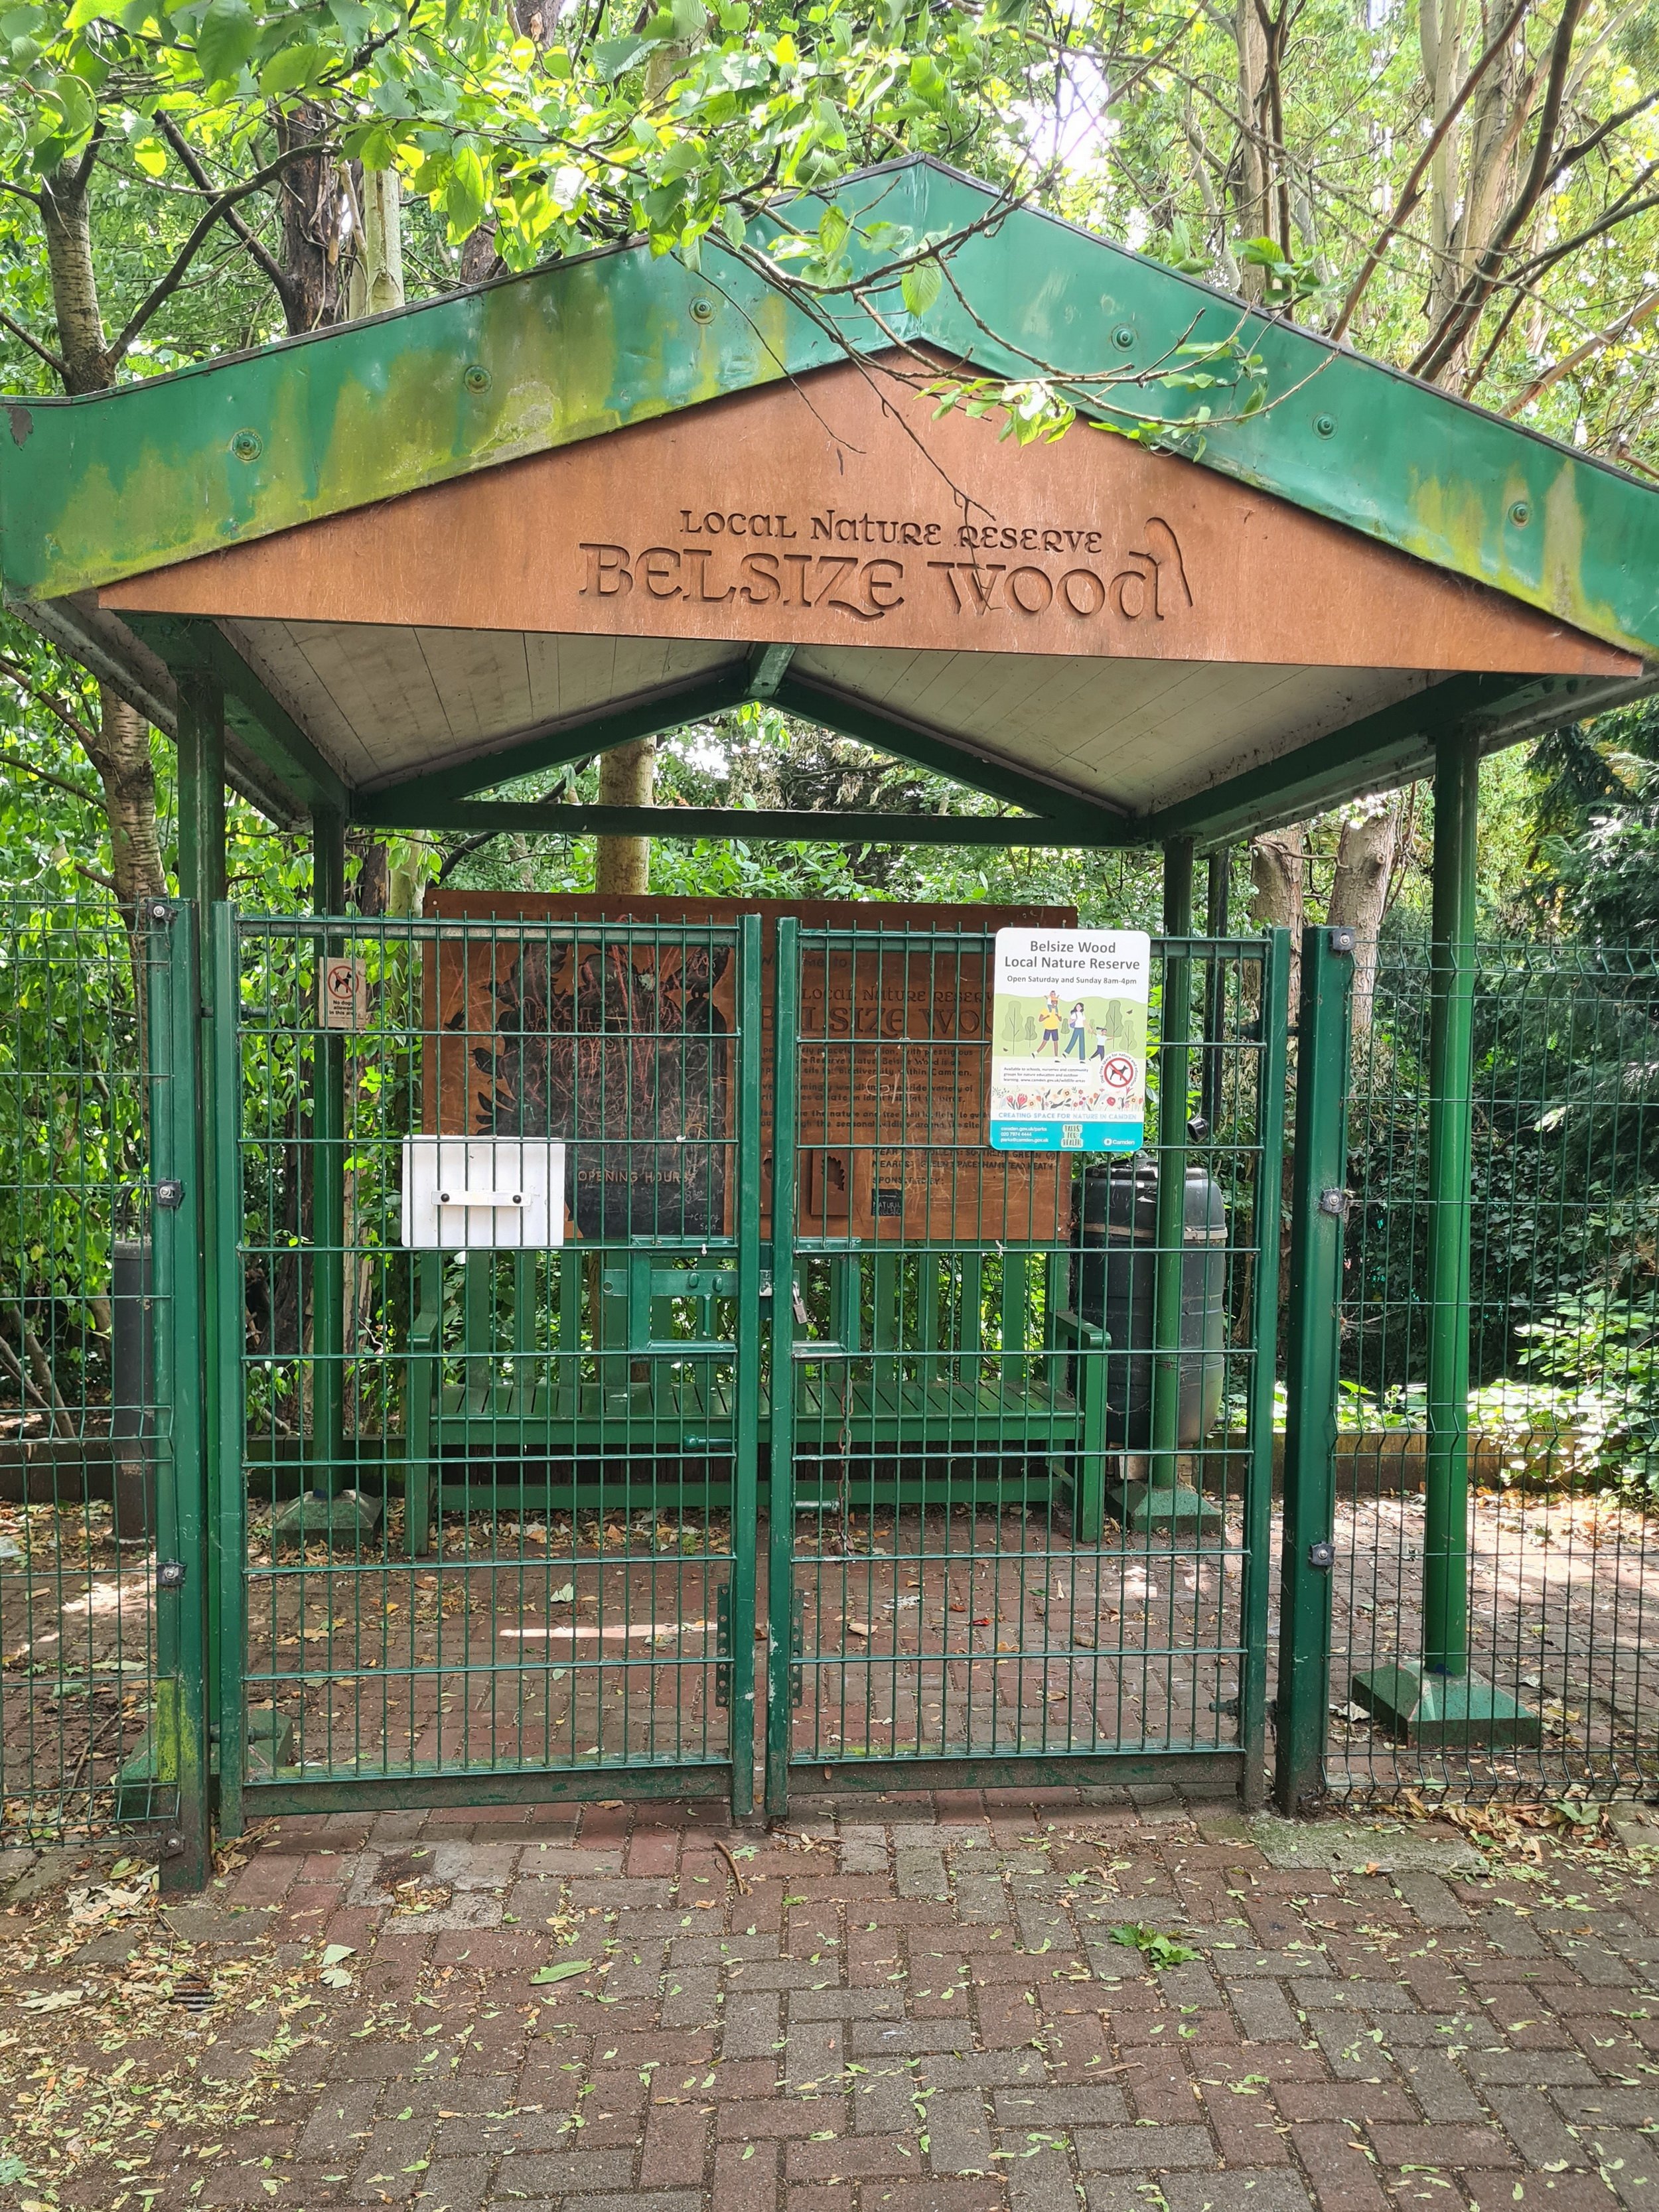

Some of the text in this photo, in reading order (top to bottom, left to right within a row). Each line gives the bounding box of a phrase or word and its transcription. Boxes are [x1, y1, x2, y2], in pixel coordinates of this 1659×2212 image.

[954, 523, 1102, 553] RESERVE
[579, 542, 904, 622] BELSIZE
[1030, 940, 1116, 953] Belsize Wood
[1005, 956, 1140, 970] Local Nature Reserve
[934, 991, 993, 1004] RESERV
[761, 1006, 904, 1038] BLSIZE
[924, 1048, 974, 1057] pestigous
